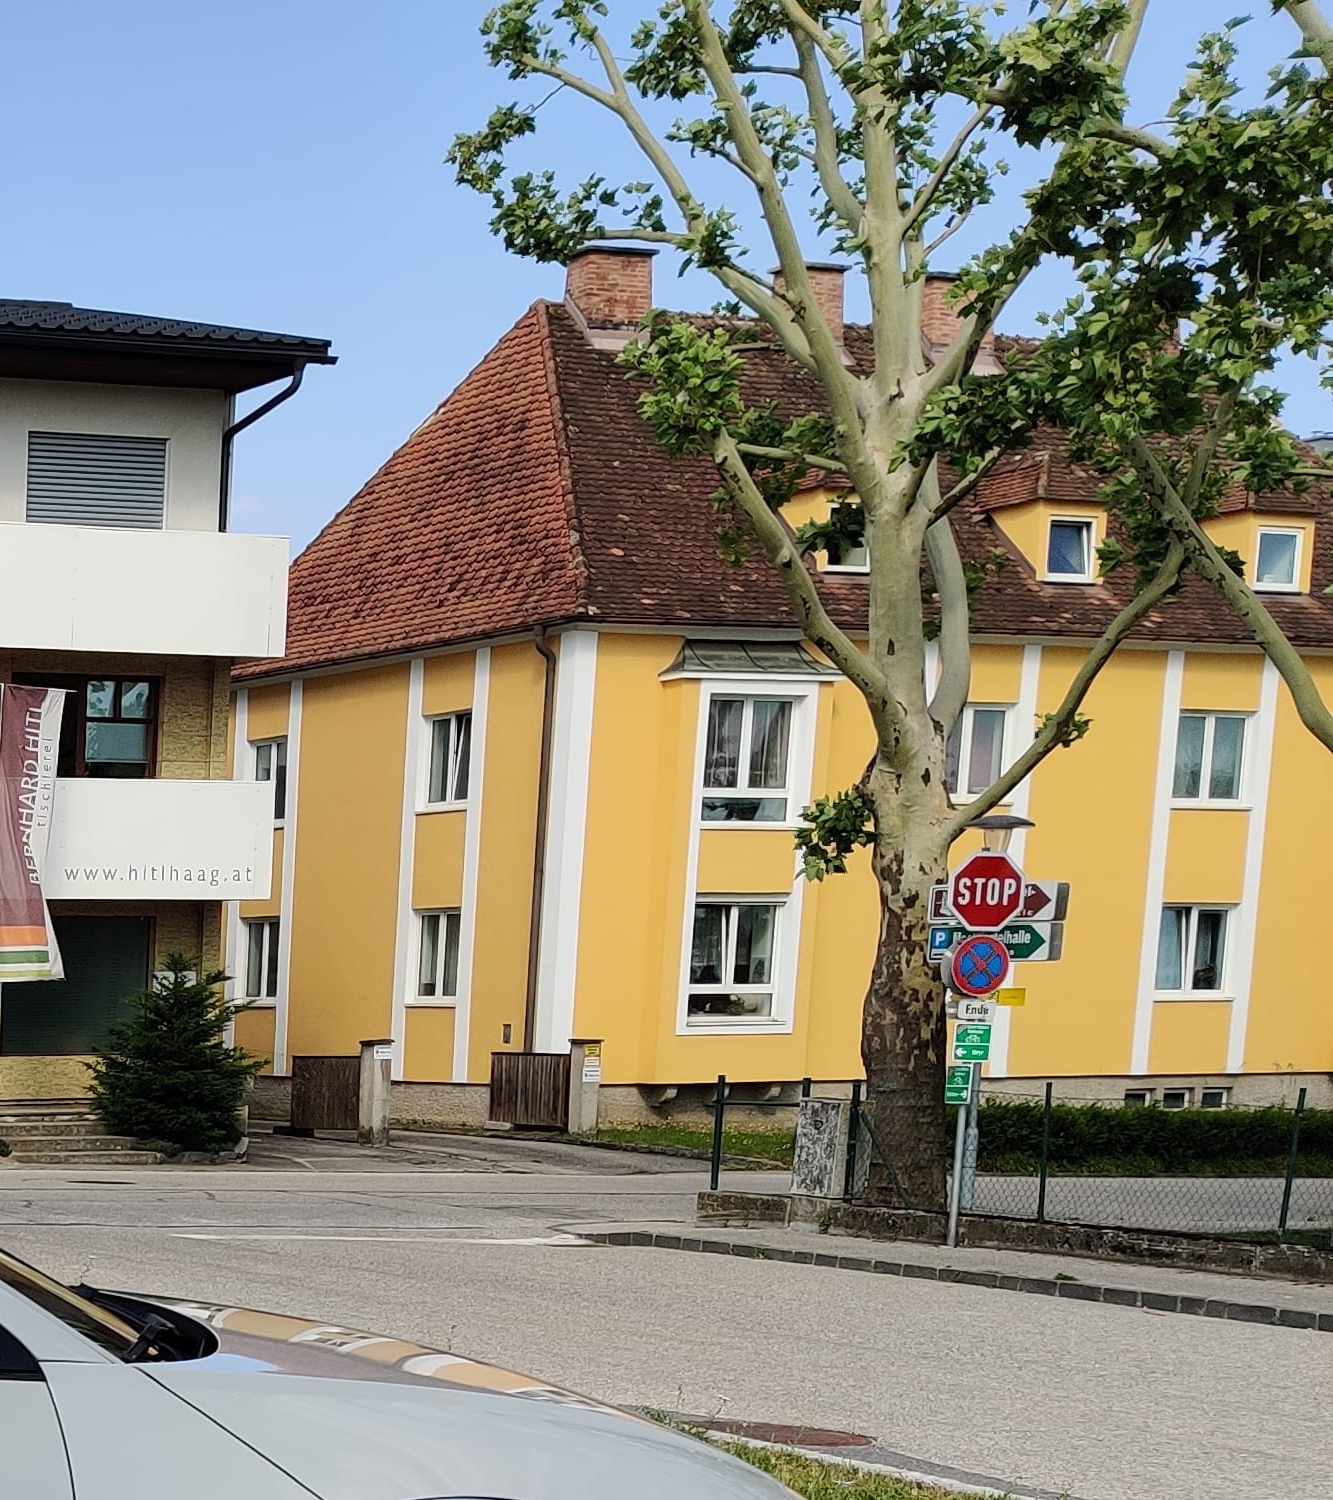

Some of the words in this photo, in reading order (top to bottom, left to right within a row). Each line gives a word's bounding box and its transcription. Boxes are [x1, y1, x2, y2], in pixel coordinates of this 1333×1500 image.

[64, 864, 253, 887] www.hitlhaag.at
[957, 877, 1017, 906] STOP
[935, 932, 946, 946] P
[965, 1003, 989, 1016] Ende
